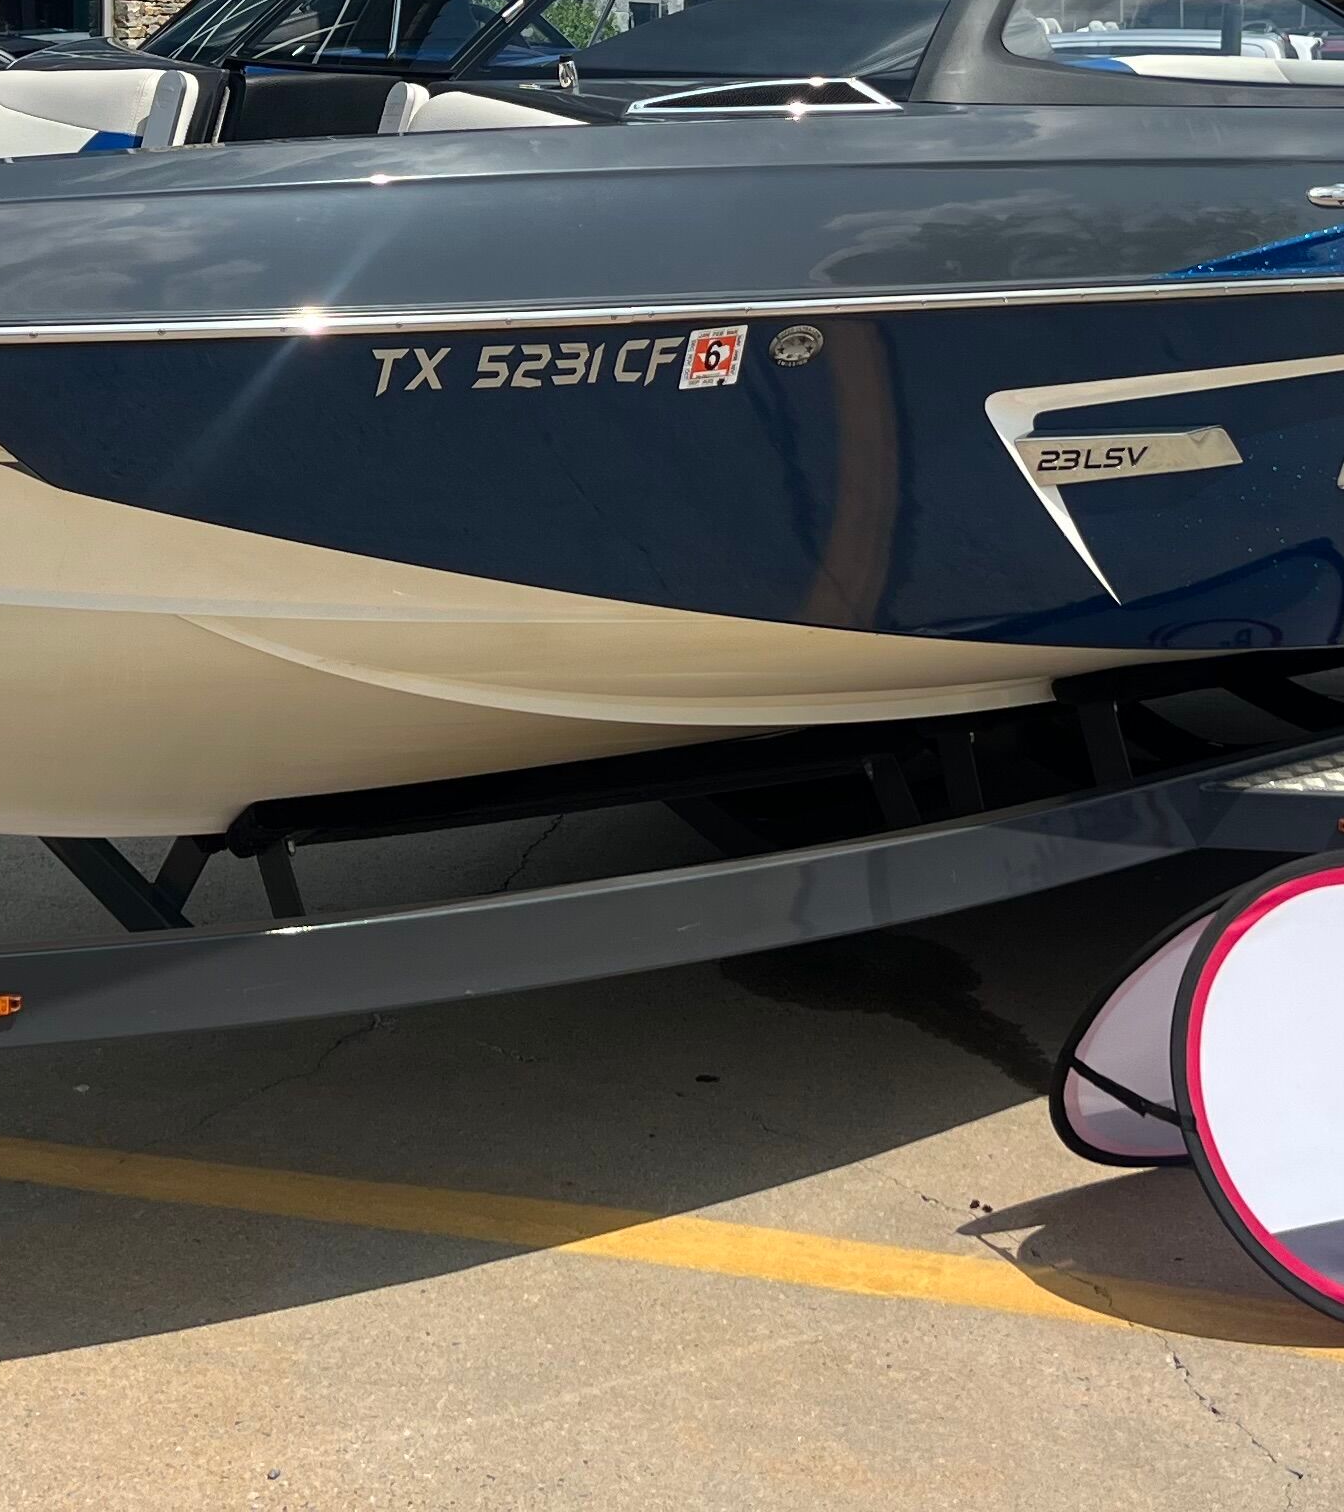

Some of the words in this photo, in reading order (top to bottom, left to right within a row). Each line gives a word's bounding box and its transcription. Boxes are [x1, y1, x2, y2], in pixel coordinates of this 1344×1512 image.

[372, 347, 452, 397] TX
[471, 342, 605, 389] 5231
[614, 336, 686, 387] CF
[704, 340, 723, 371] 6
[1037, 445, 1149, 472] 23LSV
